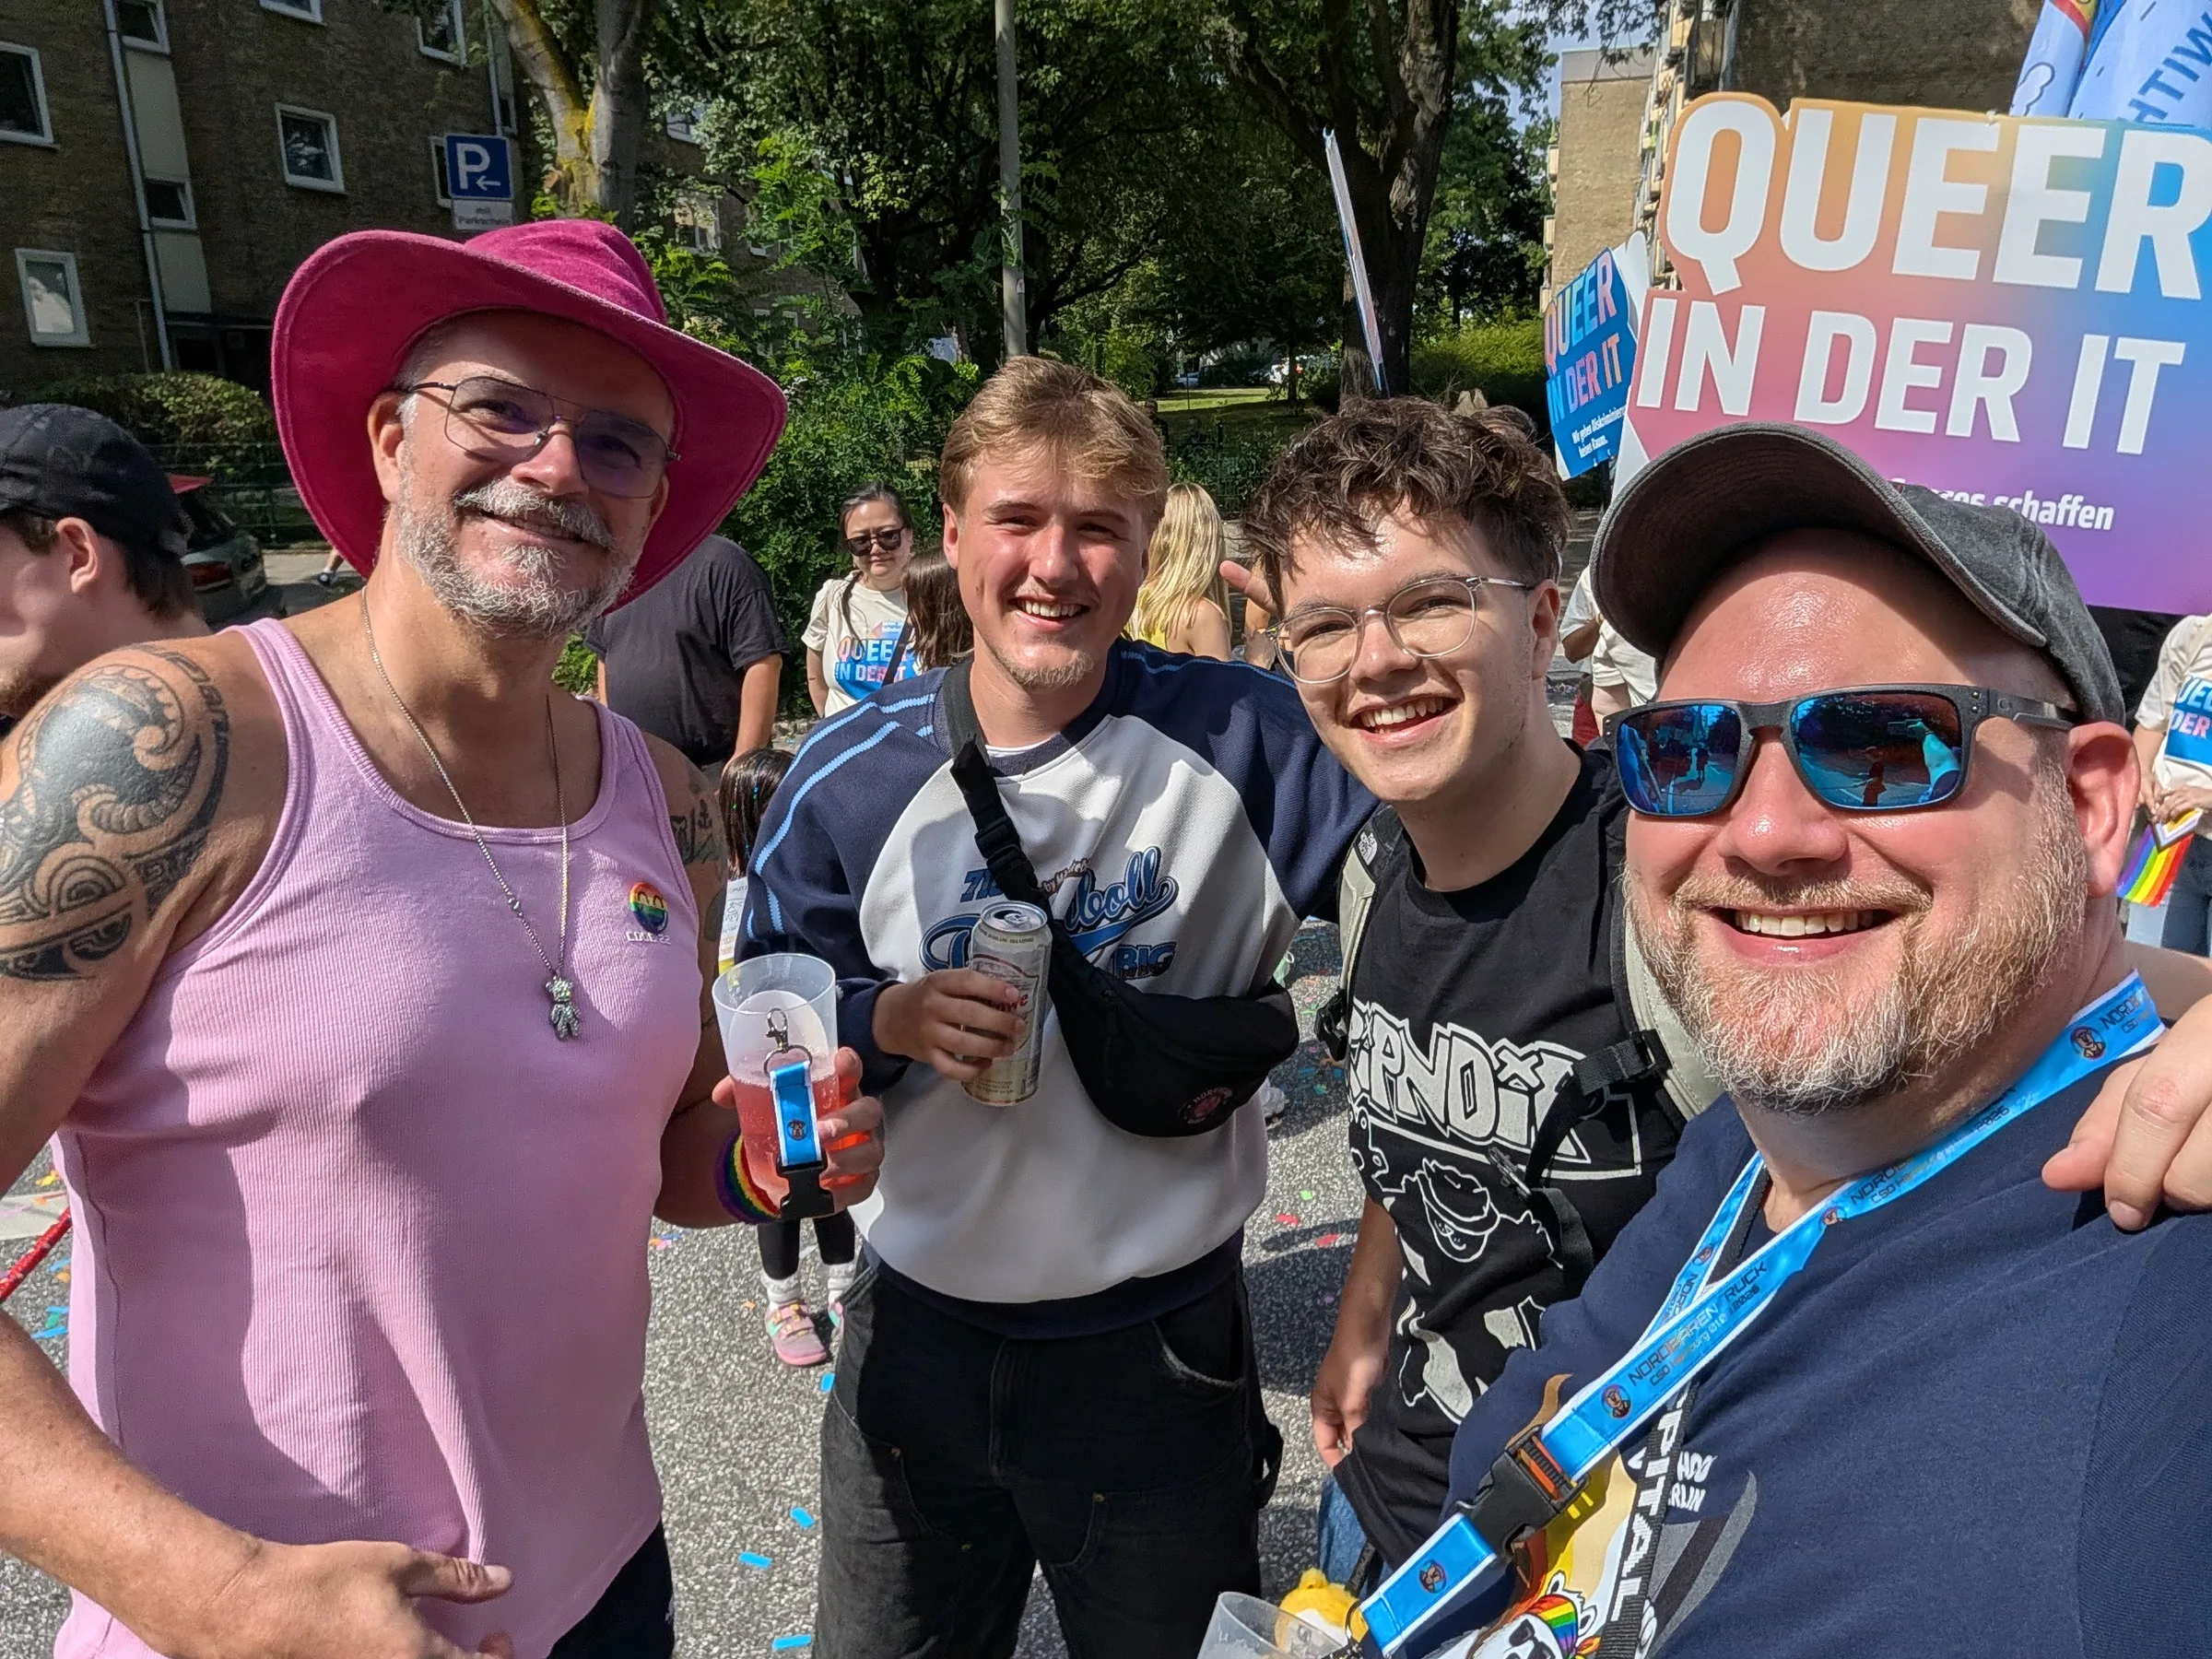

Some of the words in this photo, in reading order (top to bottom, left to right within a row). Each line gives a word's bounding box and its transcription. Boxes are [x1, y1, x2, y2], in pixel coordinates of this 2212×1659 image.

[456, 142, 490, 190] P
[1666, 100, 2212, 300] QUEER
[1545, 250, 1617, 376] QUEER
[1546, 375, 1565, 427] IN
[1566, 350, 1602, 414] DER
[1602, 333, 1622, 389] IT
[1637, 299, 1766, 417] IN
[1794, 311, 2031, 442] DER
[2063, 335, 2186, 455] IT
[837, 635, 908, 663] QUEE
[1668, 1481, 1707, 1512] RLIN
